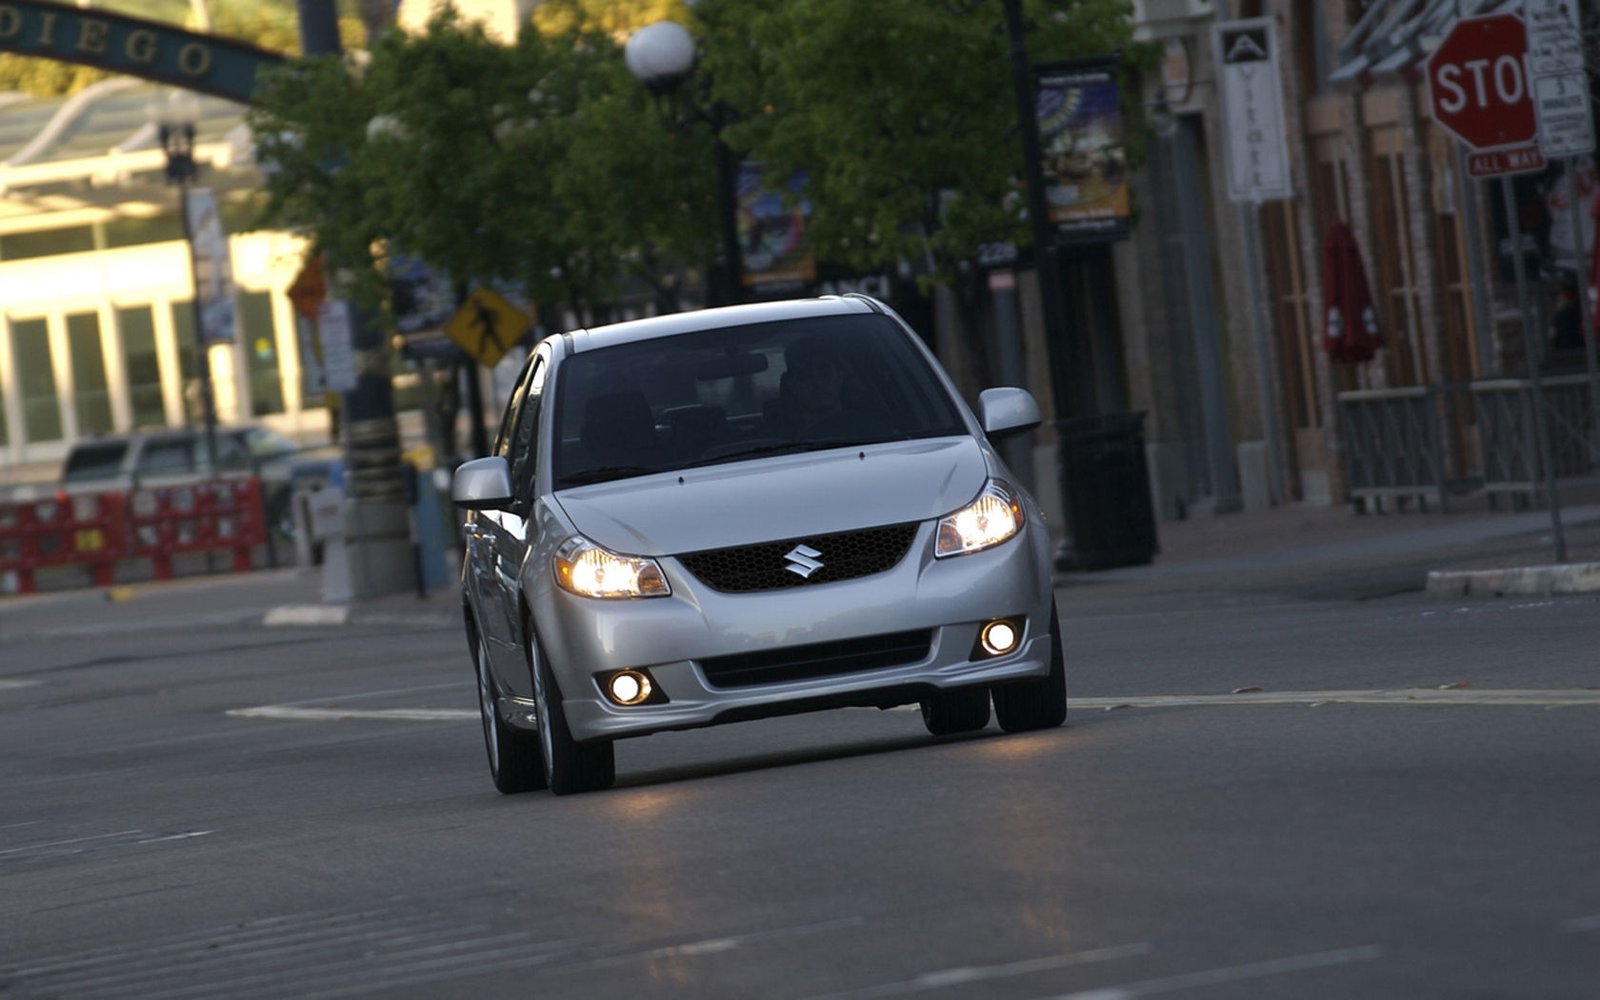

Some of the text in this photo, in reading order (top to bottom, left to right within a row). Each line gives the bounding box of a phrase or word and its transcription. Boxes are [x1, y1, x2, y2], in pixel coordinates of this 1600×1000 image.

[0, 5, 212, 76] DIEGO
[1473, 150, 1540, 172] ALL WAY
